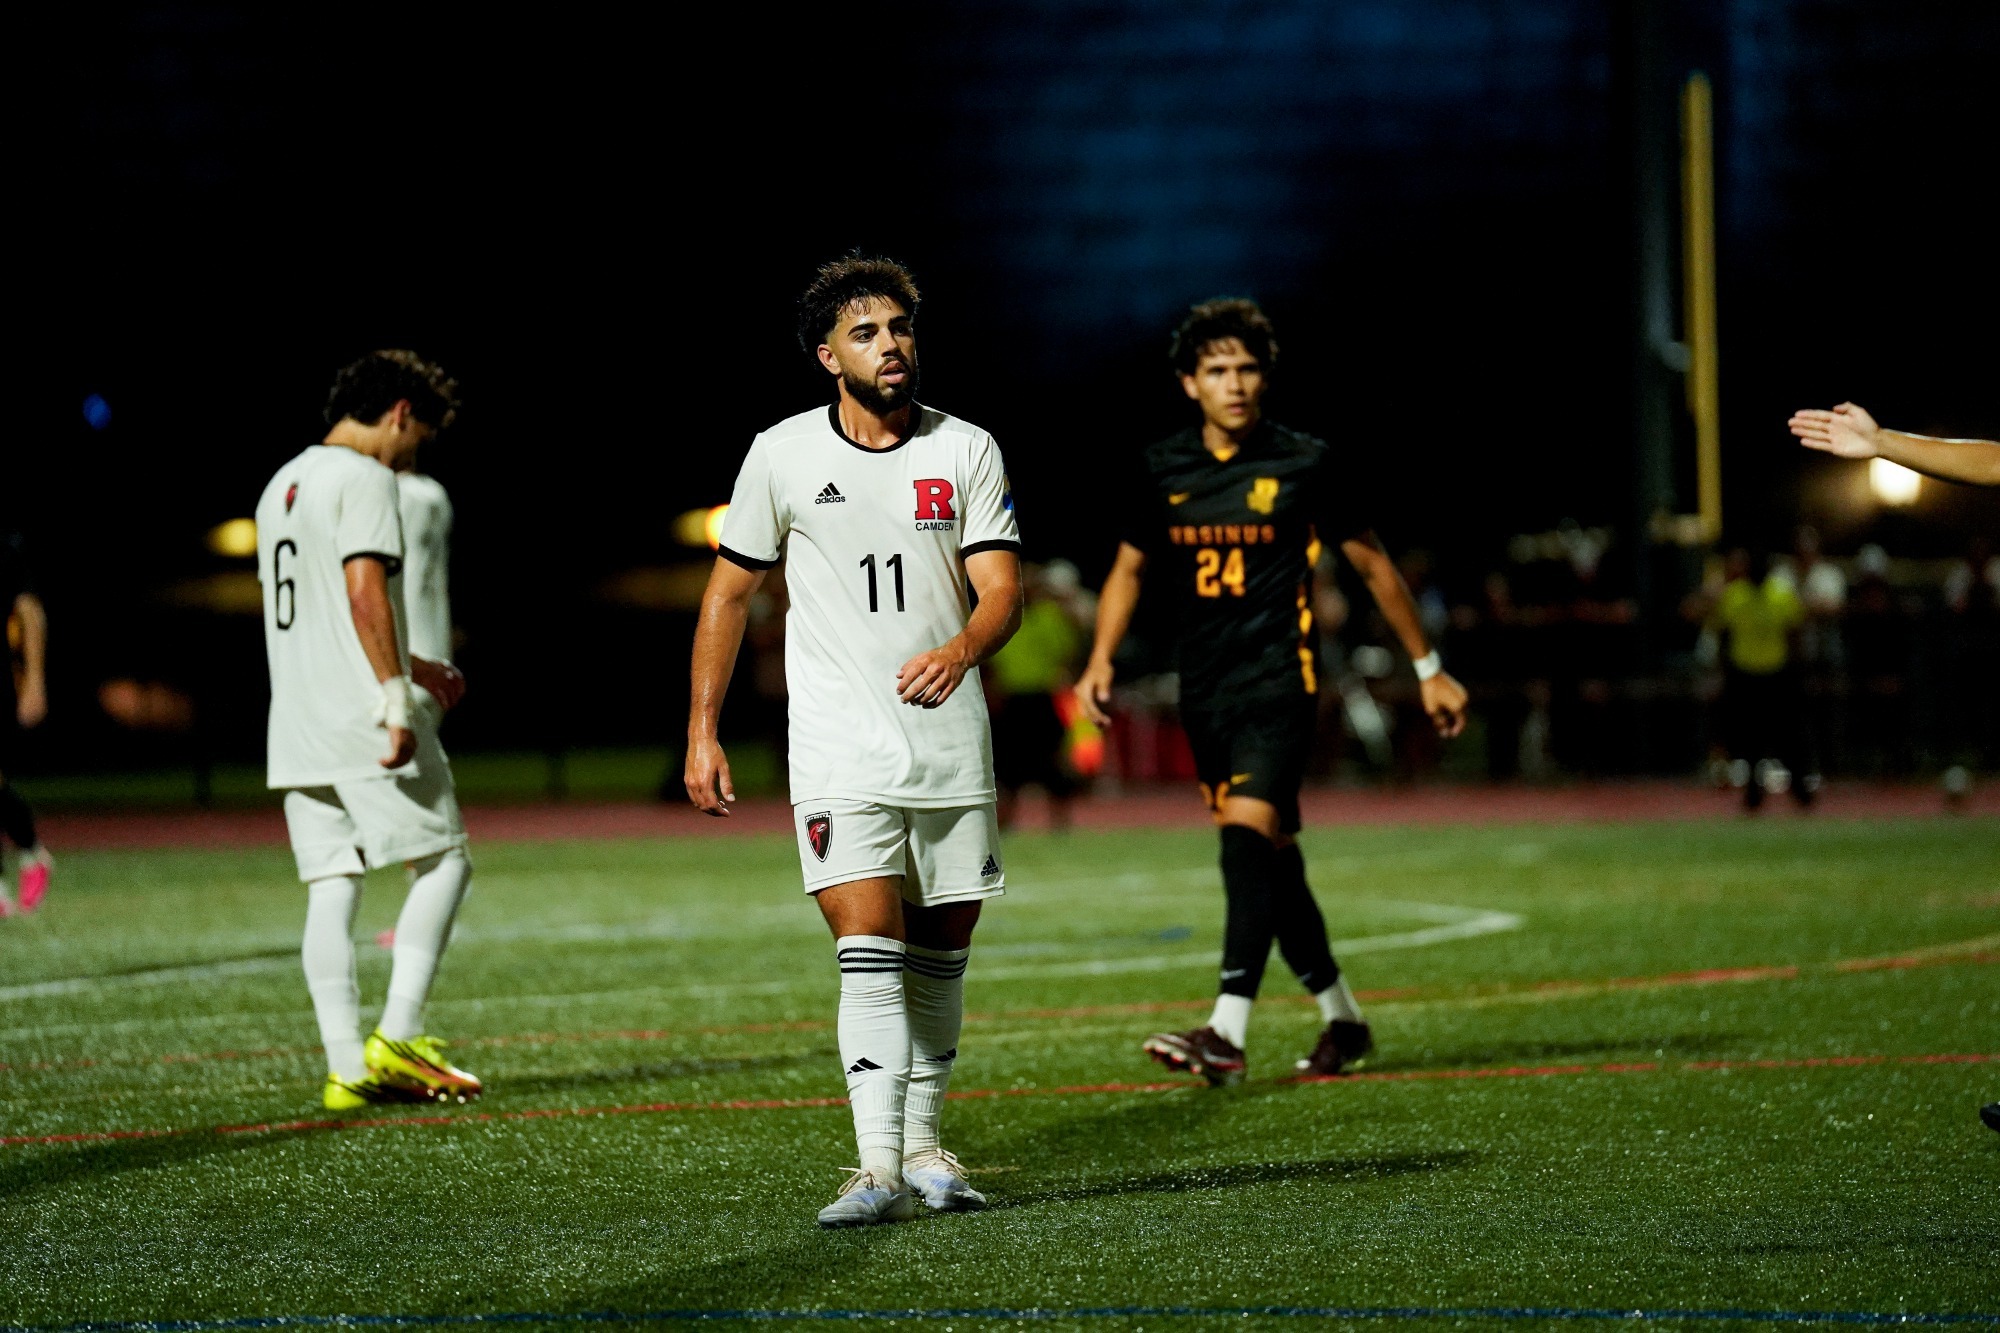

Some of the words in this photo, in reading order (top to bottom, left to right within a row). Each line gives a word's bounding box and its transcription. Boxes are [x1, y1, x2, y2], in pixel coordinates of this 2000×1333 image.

[815, 495, 846, 504] adidas
[913, 479, 956, 520] R
[915, 522, 955, 531] CAMDEN
[274, 539, 297, 631] 6
[859, 553, 905, 612] 11
[1195, 547, 1247, 598] 24
